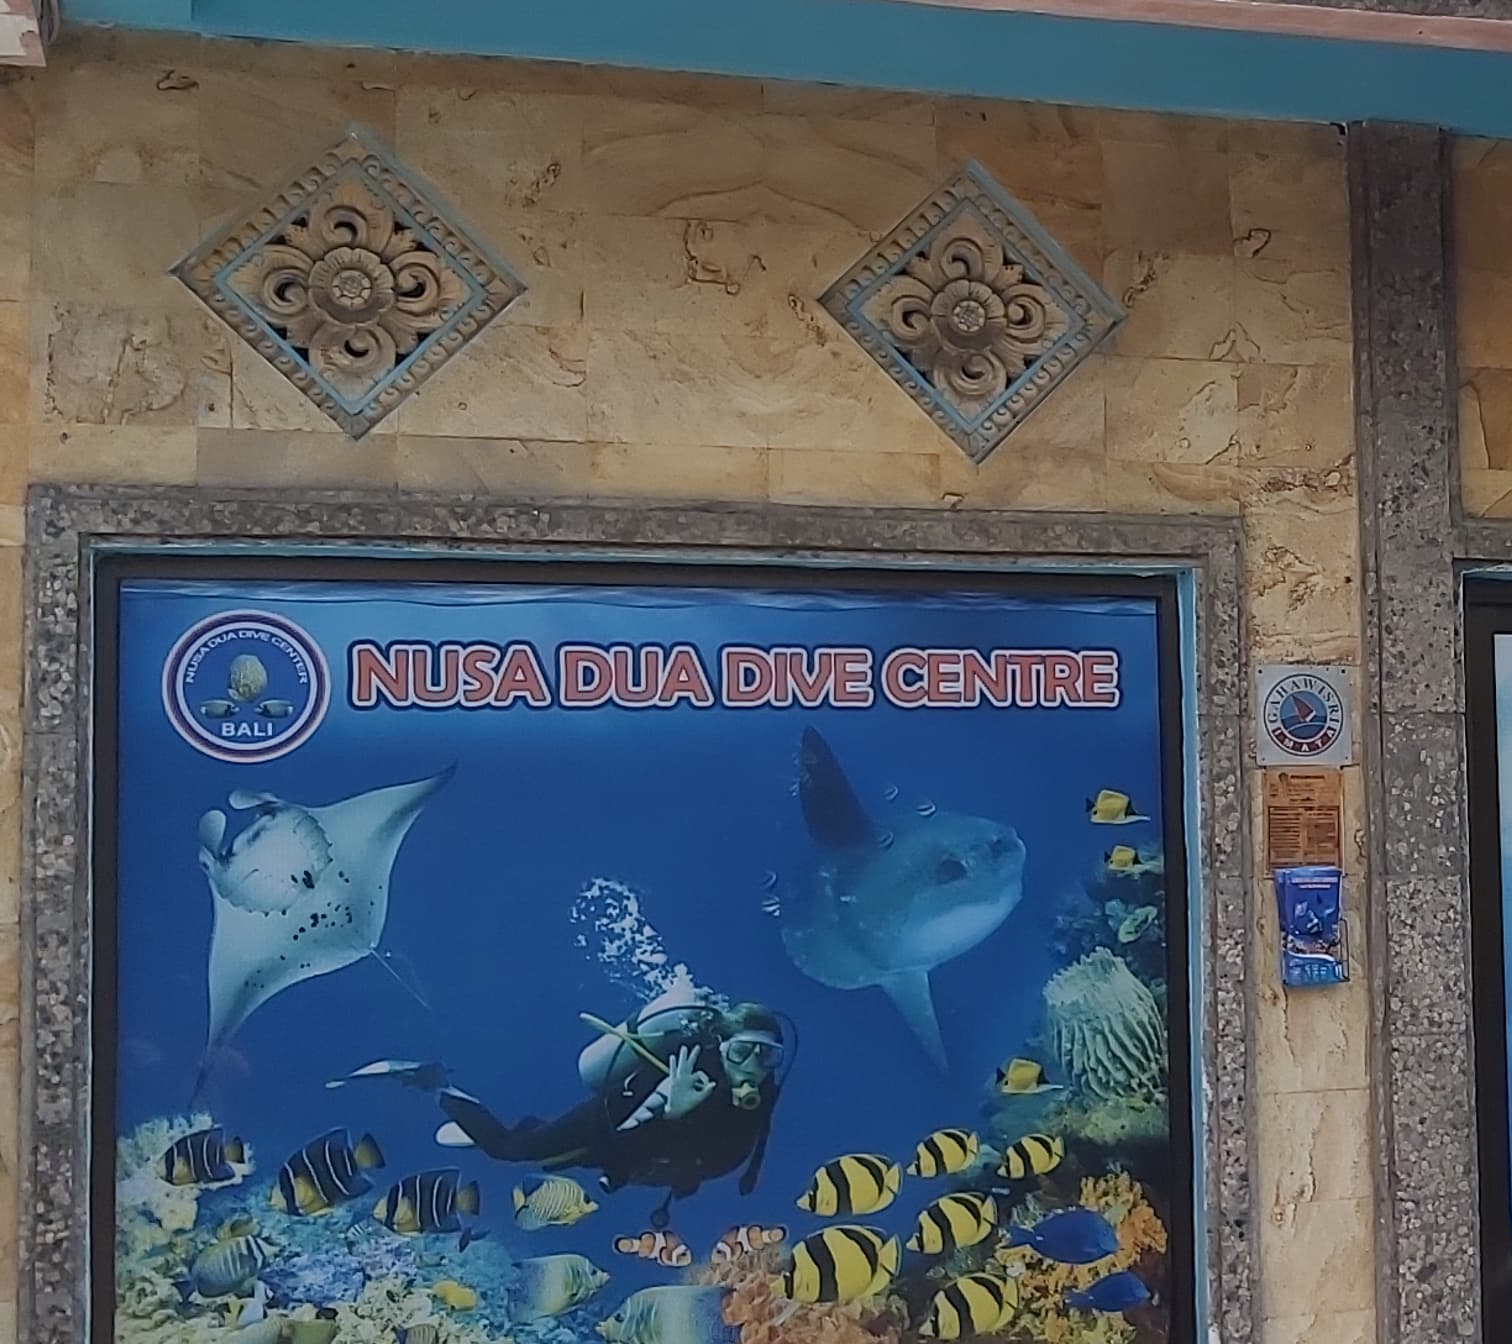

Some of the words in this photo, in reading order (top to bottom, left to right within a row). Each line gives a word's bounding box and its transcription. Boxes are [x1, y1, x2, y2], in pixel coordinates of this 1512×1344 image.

[184, 647, 210, 685] NUSA
[208, 632, 239, 649] DUA
[238, 630, 271, 643] DIVE
[271, 636, 308, 685] CENTER
[352, 642, 551, 708] NUSA
[558, 644, 715, 709] DUA
[721, 645, 874, 709] DIVE
[881, 647, 1122, 709] CENTRE
[221, 722, 274, 738] BALI
